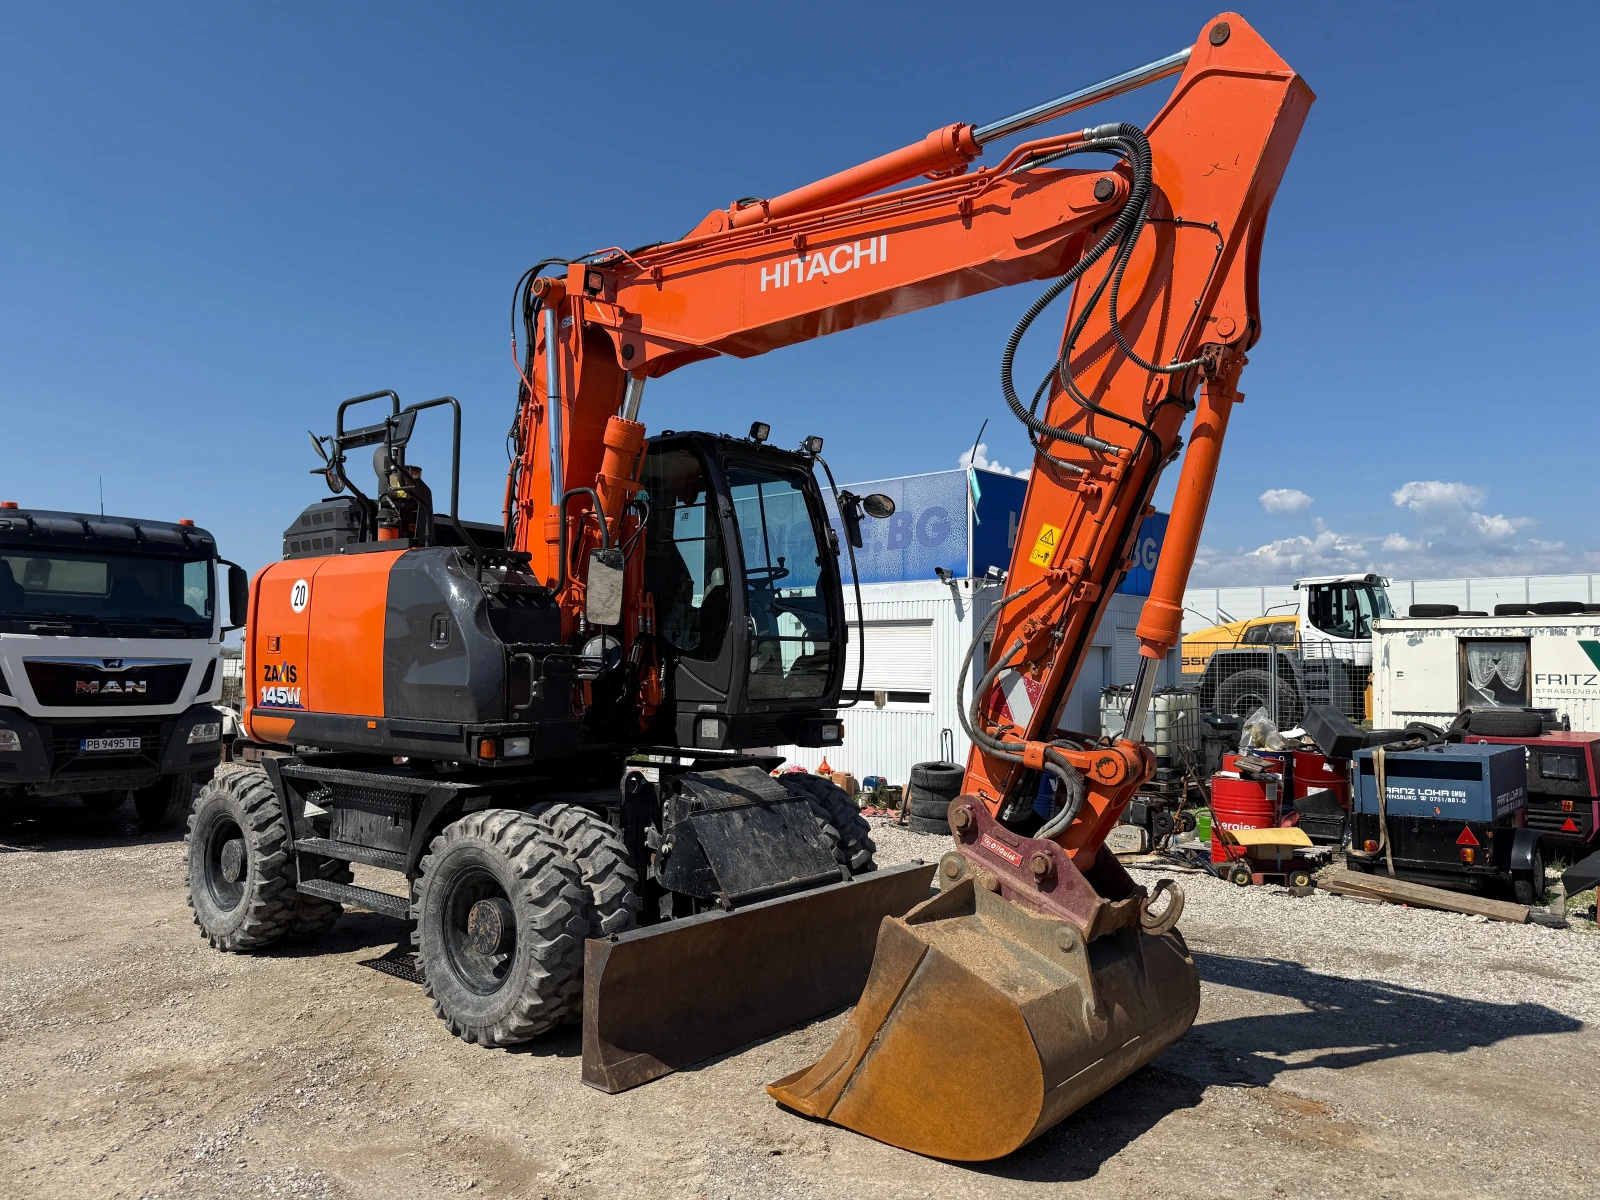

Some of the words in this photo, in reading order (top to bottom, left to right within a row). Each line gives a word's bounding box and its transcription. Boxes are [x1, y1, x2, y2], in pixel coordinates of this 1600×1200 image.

[761, 235, 887, 292] HITACHI
[293, 585, 306, 606] 20
[264, 661, 297, 683] ZAXIS
[1535, 674, 1598, 686] FRITZ
[76, 680, 146, 693] MAN
[261, 686, 301, 705] 145W
[87, 740, 100, 749] PB
[102, 739, 125, 748] 9495
[126, 738, 139, 747] TE
[1385, 787, 1415, 795] RANZ
[1417, 788, 1449, 797] LOHR
